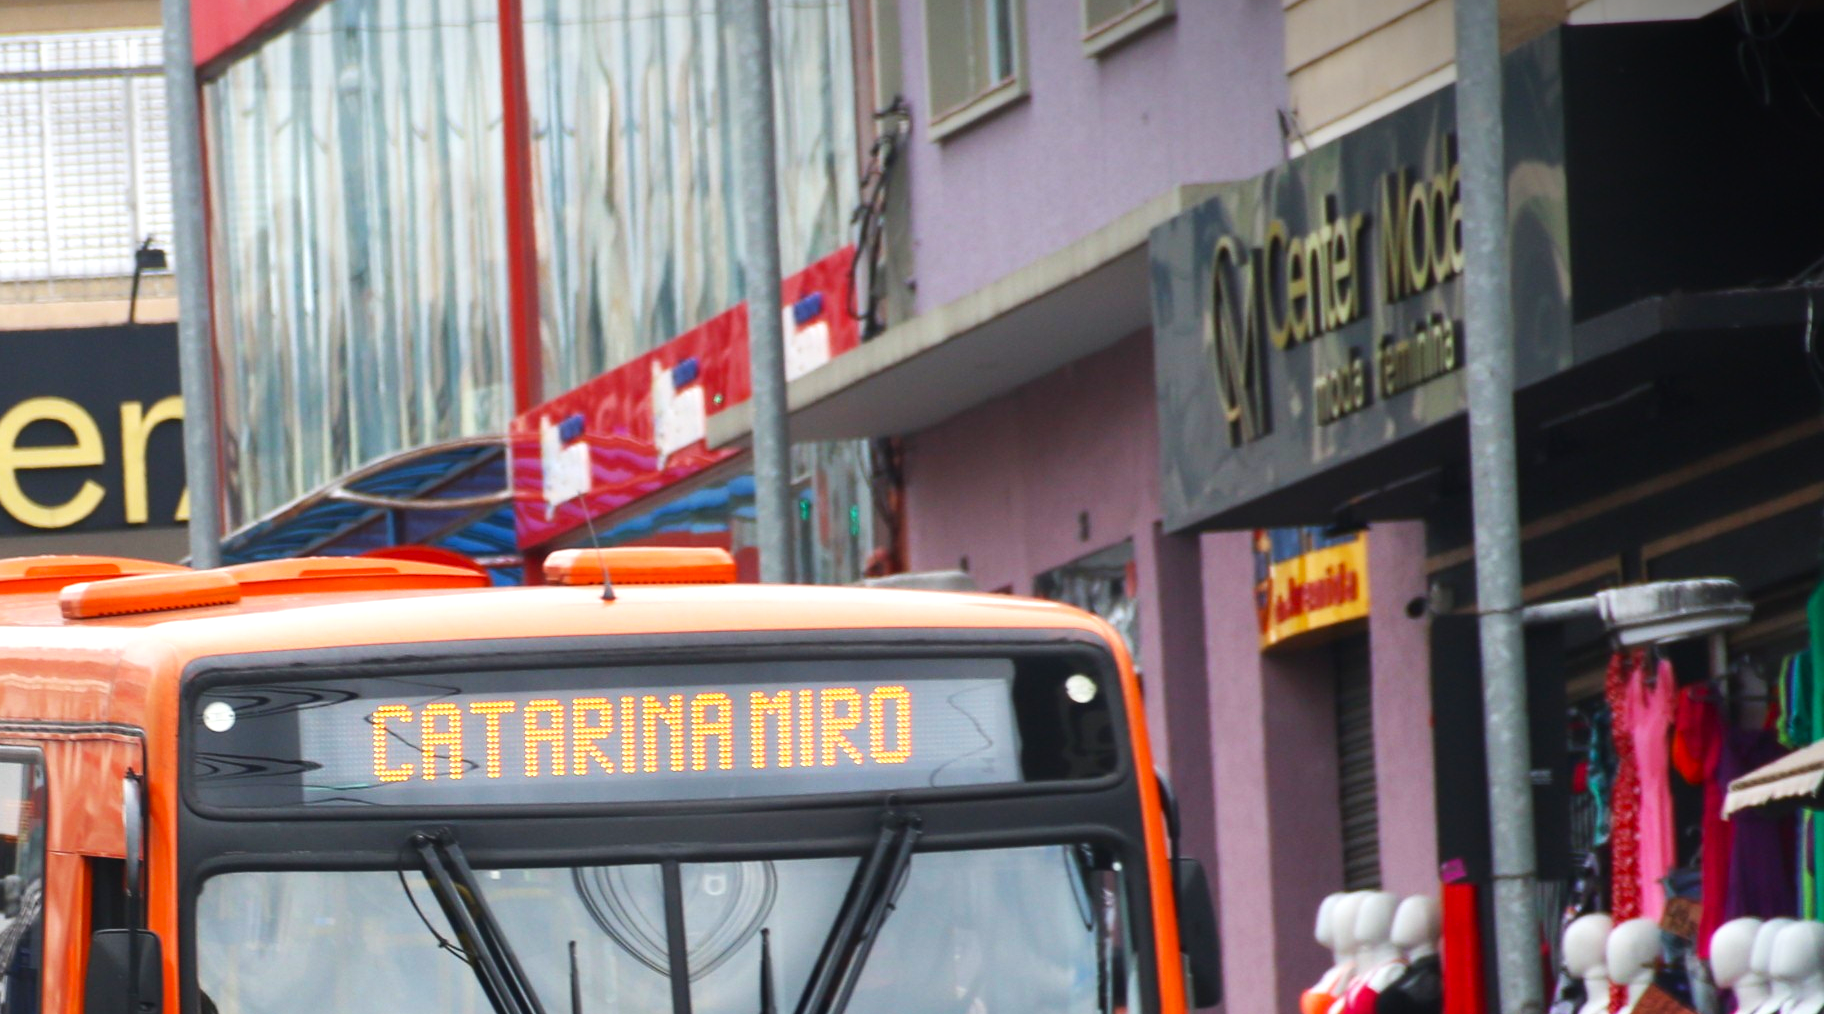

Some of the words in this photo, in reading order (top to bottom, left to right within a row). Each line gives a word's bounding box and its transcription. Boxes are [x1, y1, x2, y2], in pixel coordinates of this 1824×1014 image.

[1264, 193, 1366, 350] Center
[1314, 355, 1364, 426] moda
[1379, 317, 1456, 400] feminina
[373, 693, 734, 783] CATARINA
[749, 685, 913, 770] MIRO
